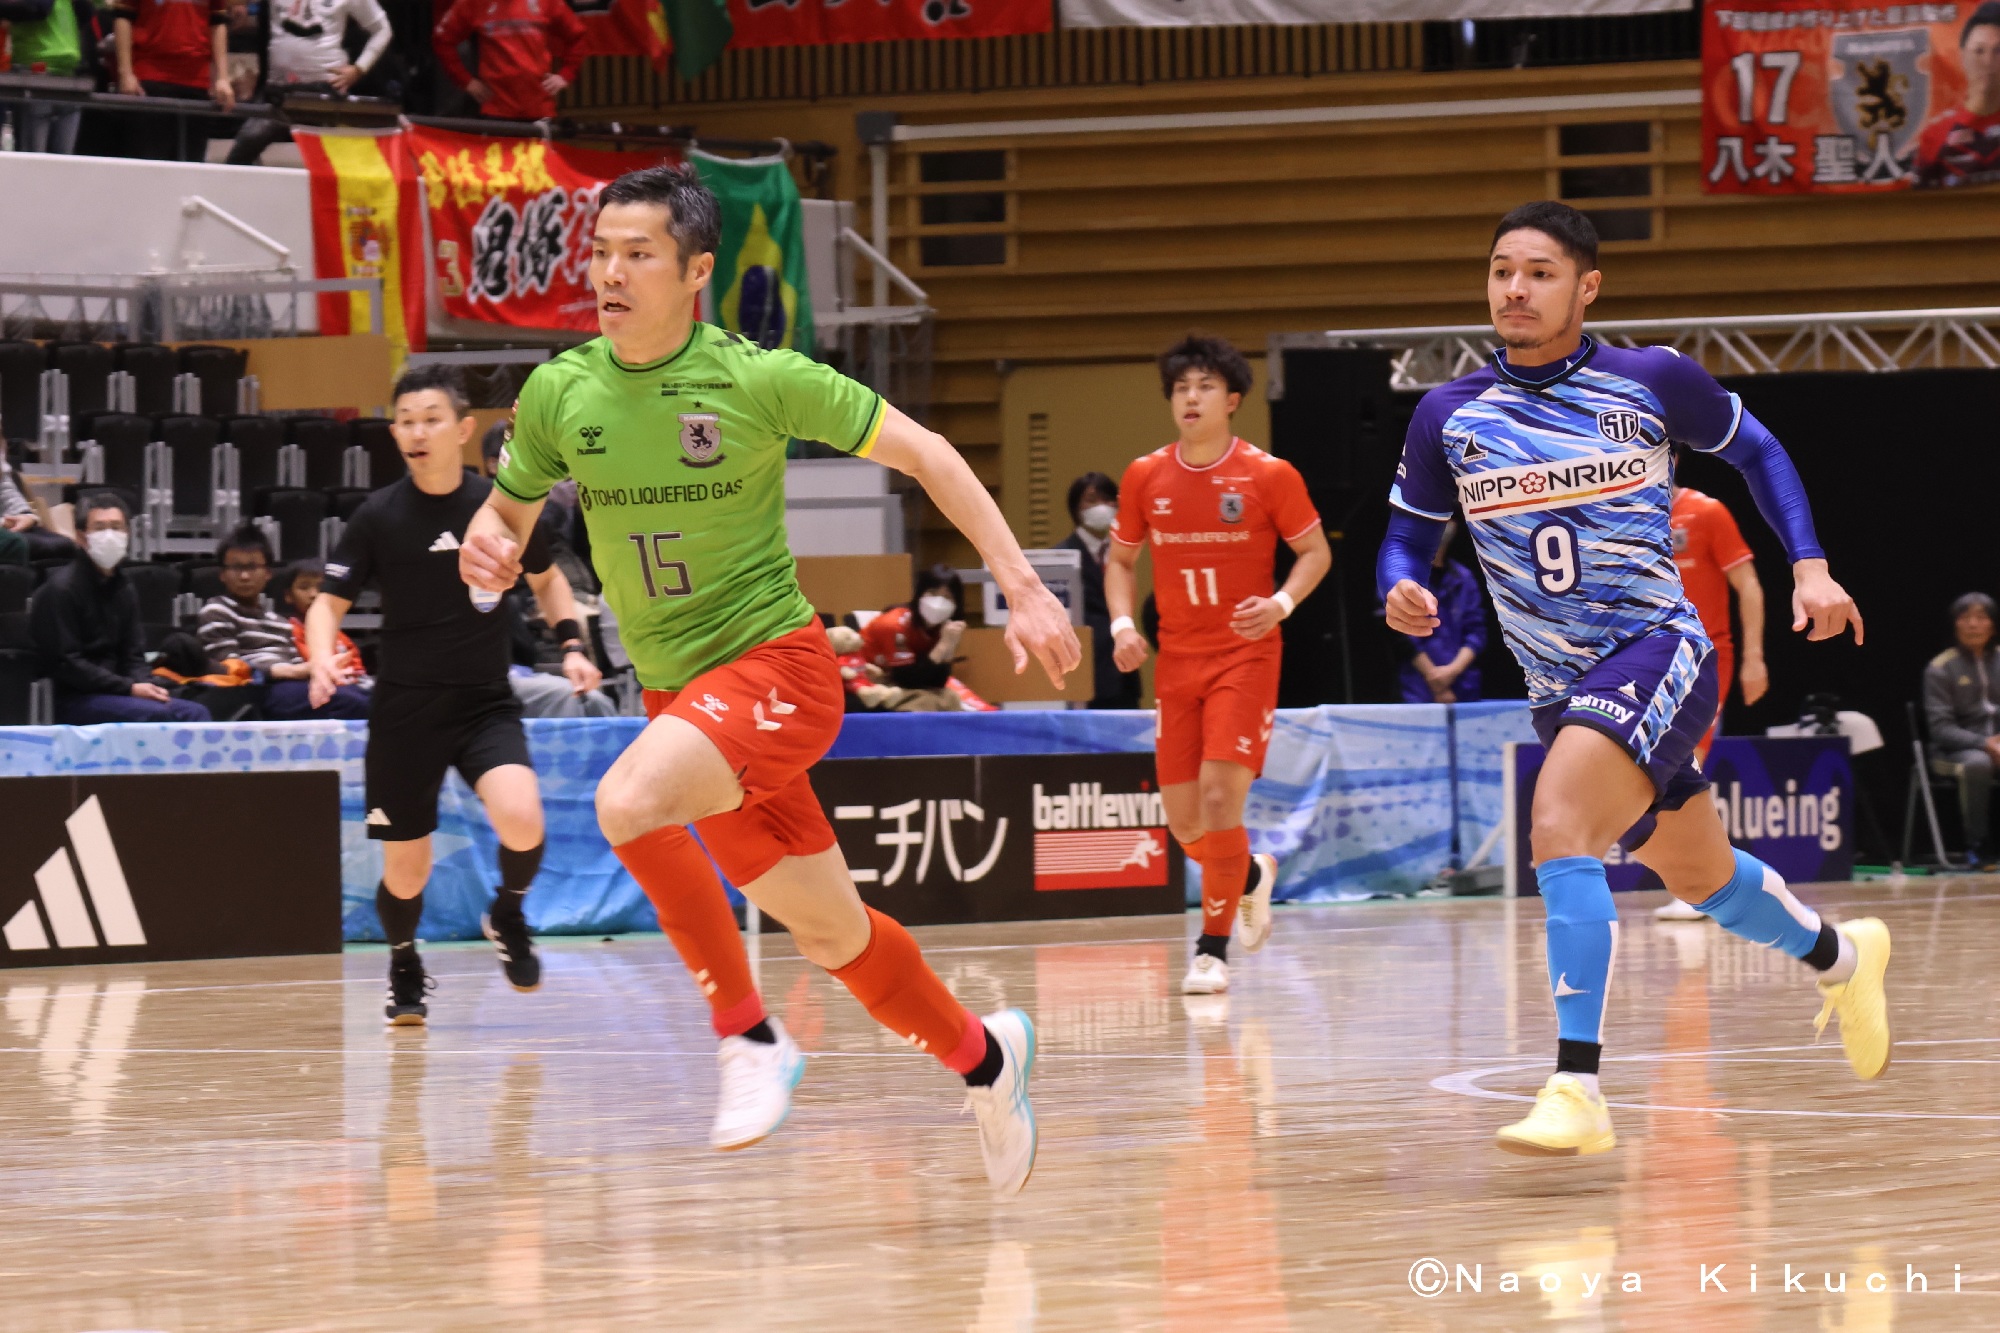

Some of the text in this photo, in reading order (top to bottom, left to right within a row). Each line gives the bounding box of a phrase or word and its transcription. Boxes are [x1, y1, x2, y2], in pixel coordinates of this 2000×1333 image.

[1731, 51, 1802, 125] 17
[1708, 132, 1906, 185] 八木 聖人
[591, 479, 743, 506] TOHO LIQUEFIED GAS
[628, 531, 693, 599] 15
[1180, 568, 1219, 606] 11
[1532, 523, 1579, 594] 9
[1032, 781, 1169, 830] battlewin
[834, 798, 1009, 887] ニチバン
